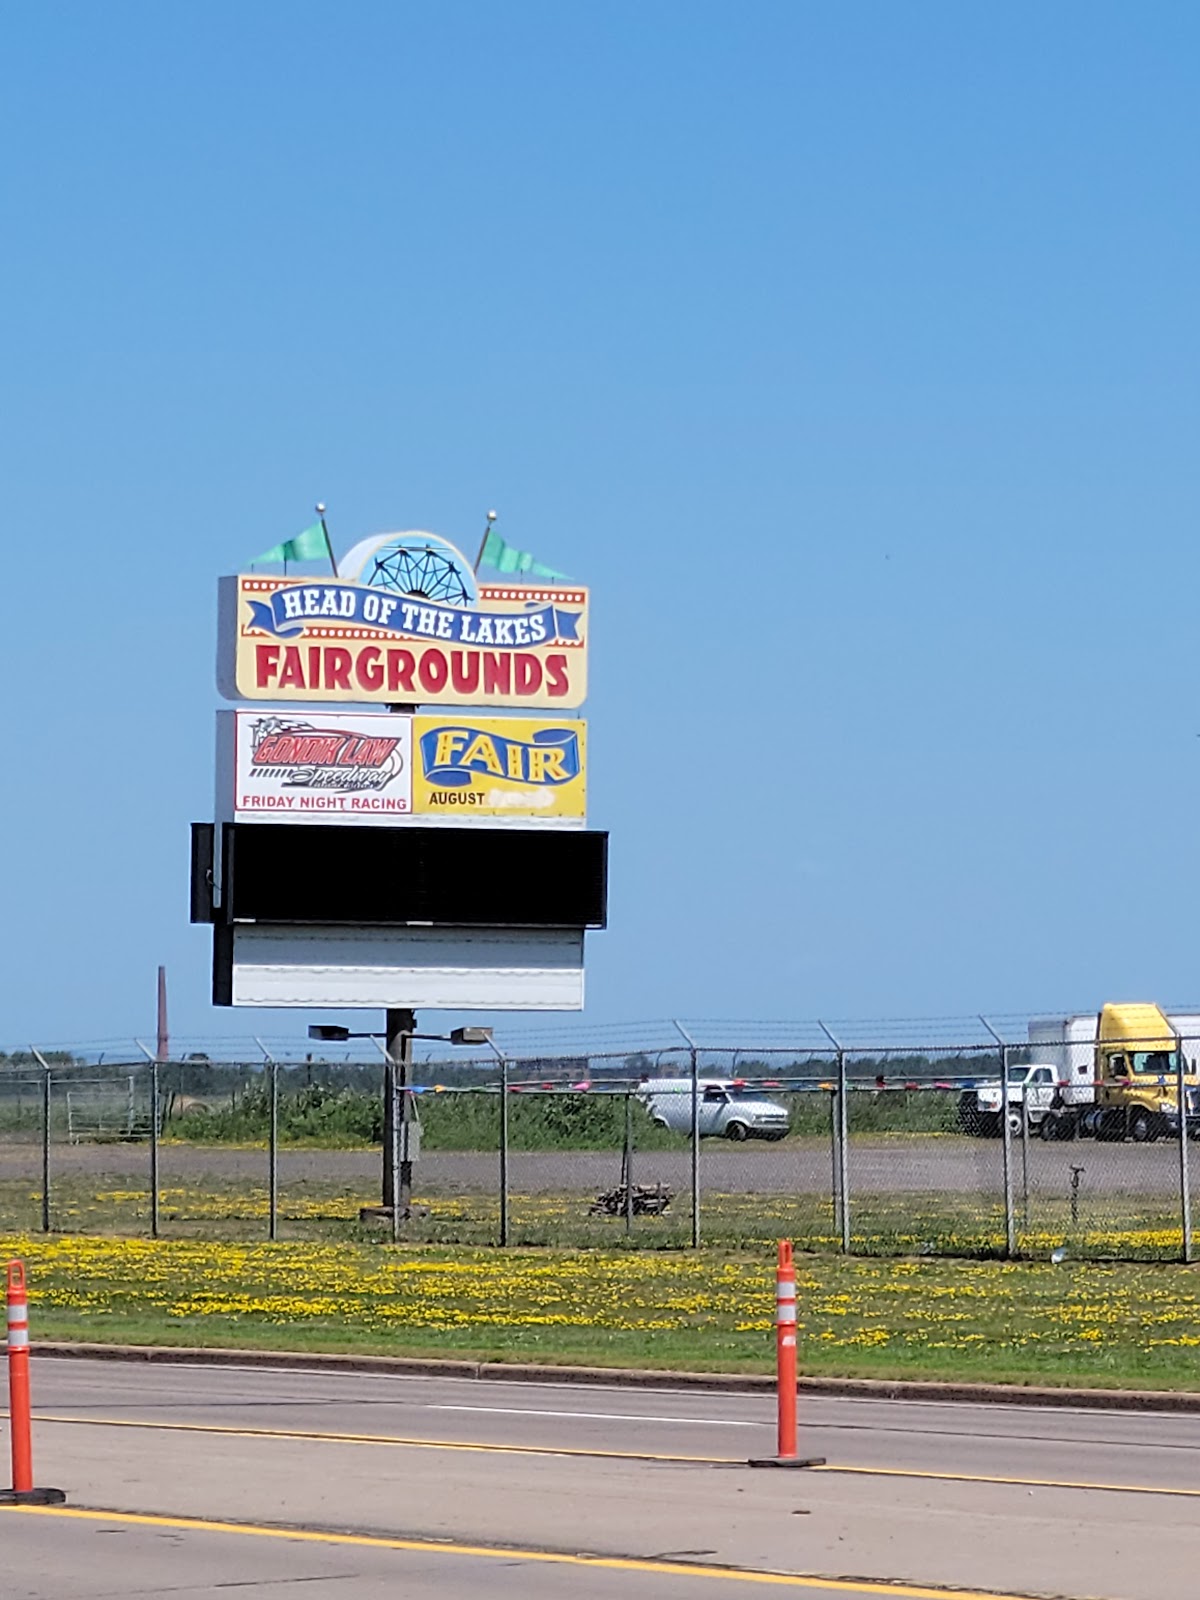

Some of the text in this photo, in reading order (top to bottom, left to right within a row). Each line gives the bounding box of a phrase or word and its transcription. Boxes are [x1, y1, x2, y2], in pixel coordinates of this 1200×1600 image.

[282, 587, 547, 646] HEAD OF THE LAKES
[256, 644, 570, 698] FAIRGROUNDS
[254, 736, 397, 766] GONDIK LAW
[432, 730, 573, 782] FAIR
[289, 765, 393, 791] Speedway
[242, 795, 407, 810] FRIDAY NIGHT RACING
[429, 792, 485, 805] AUGUST
